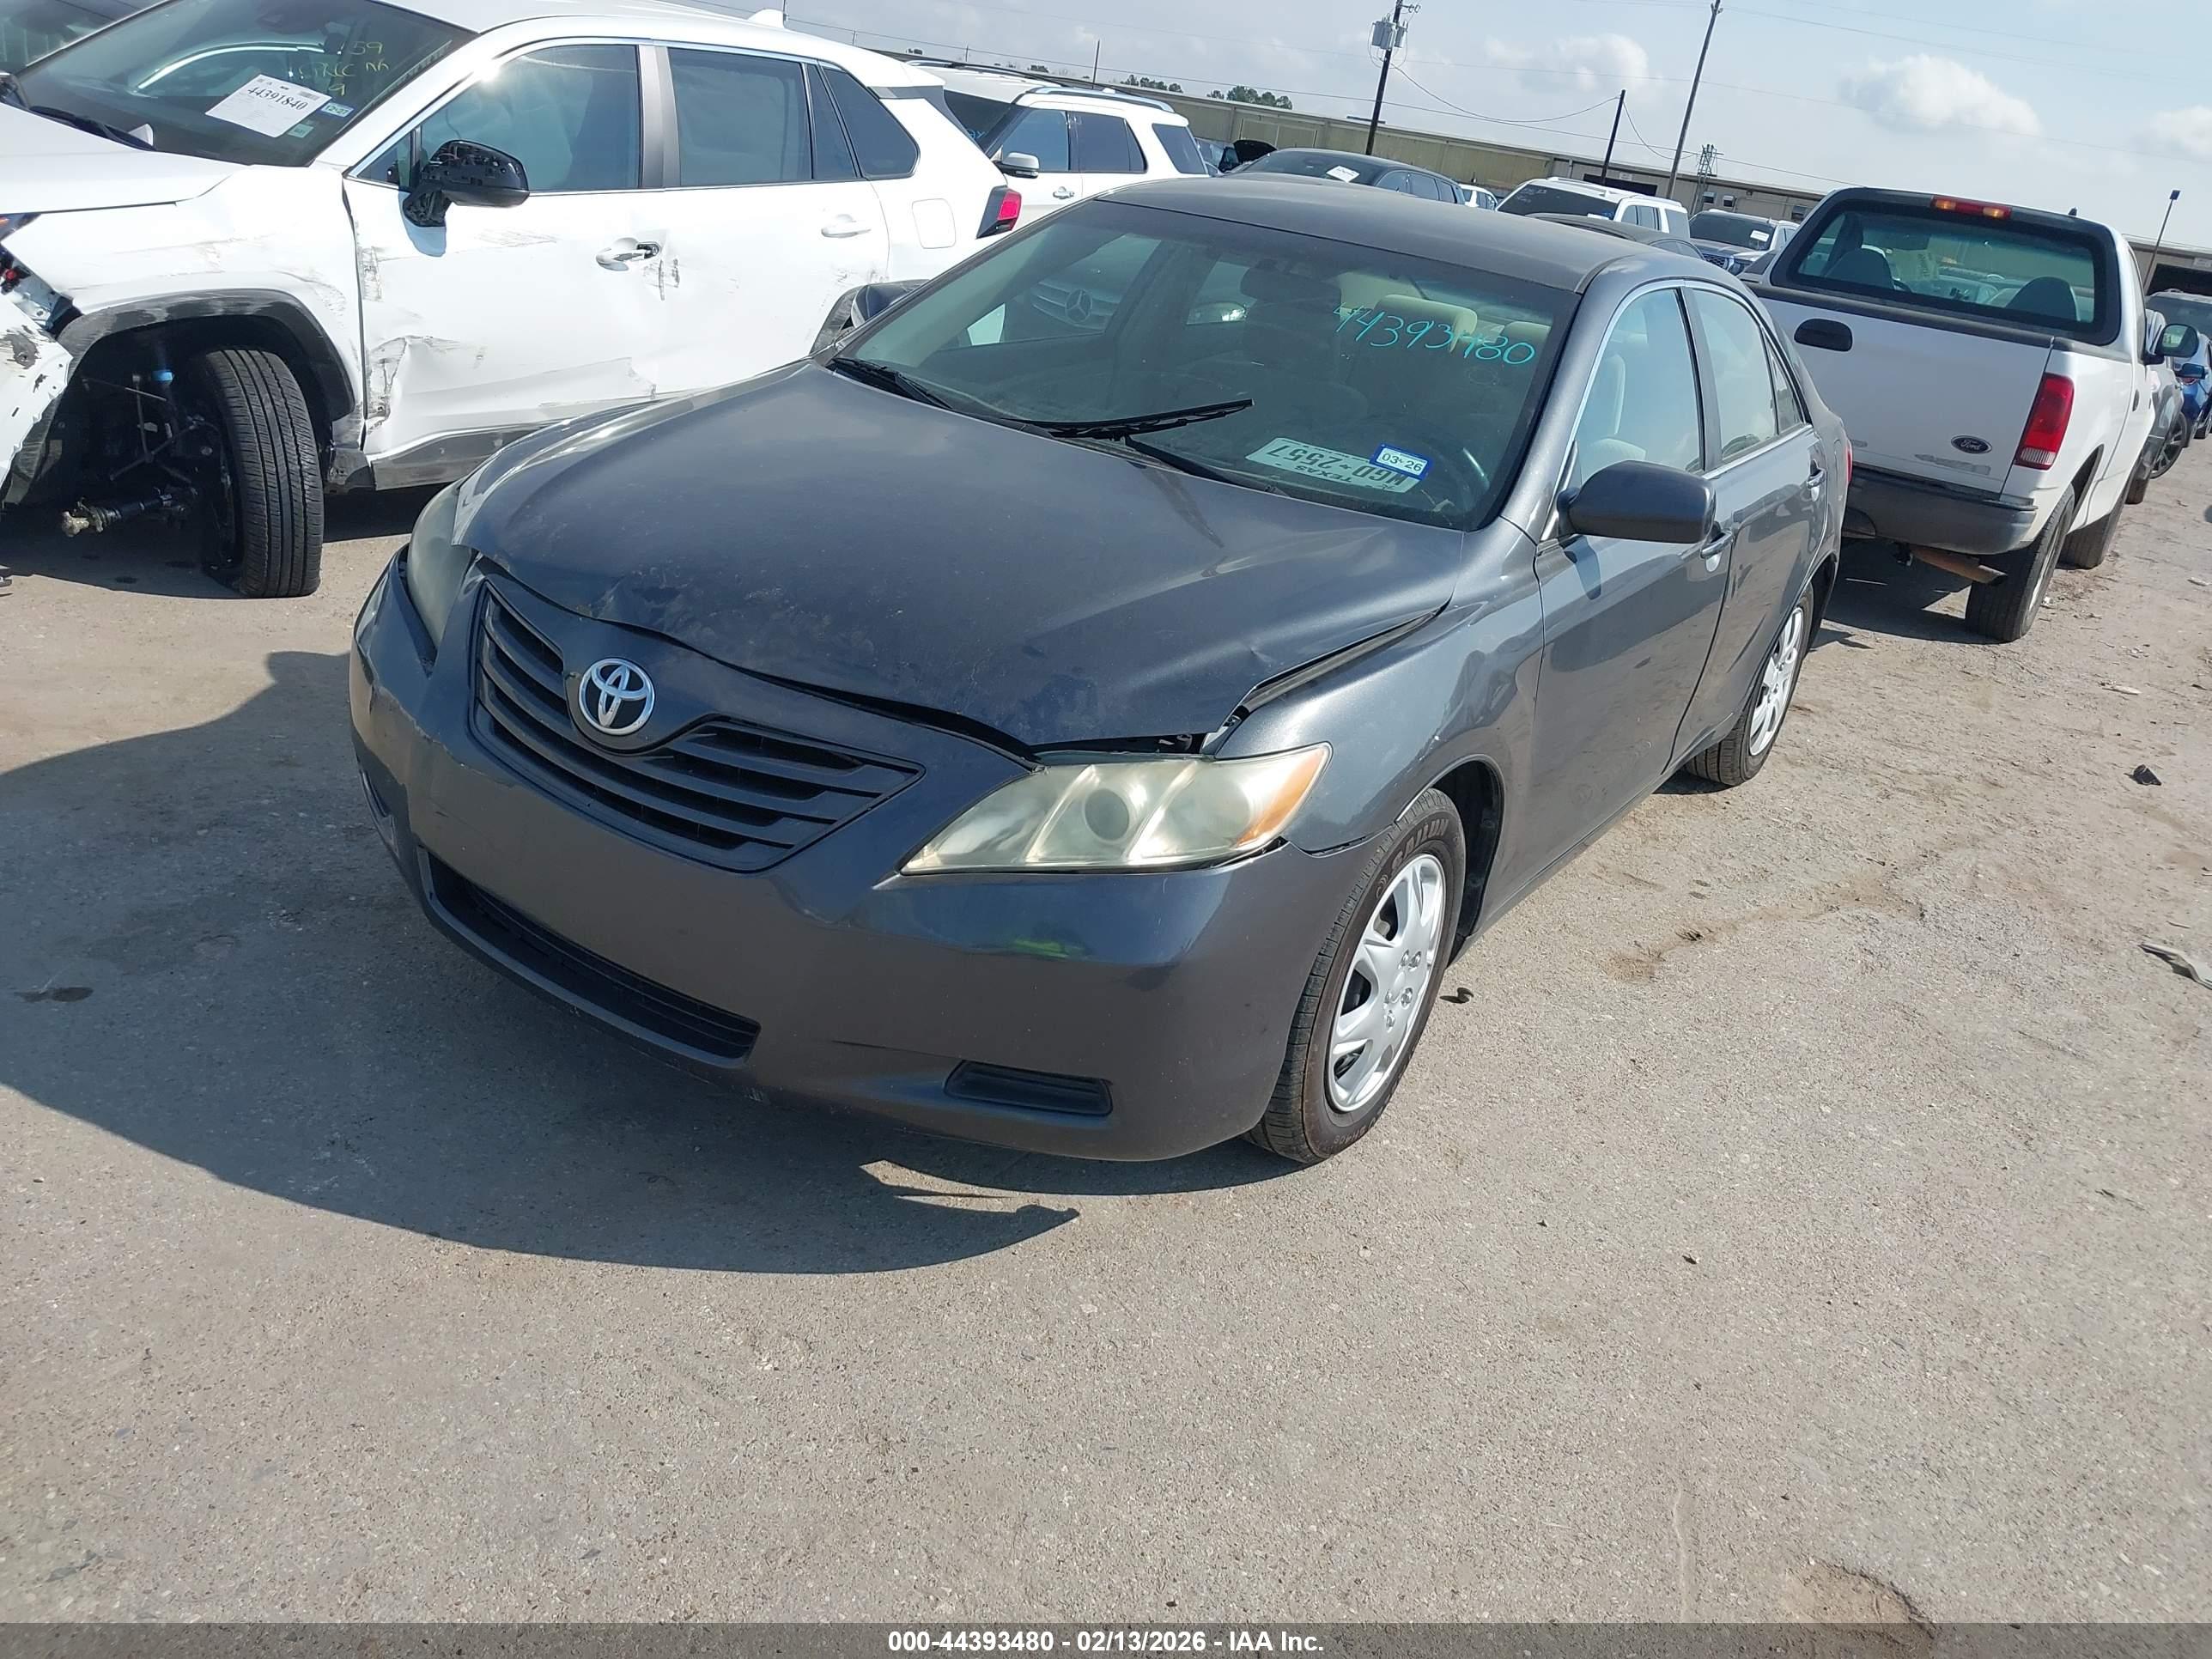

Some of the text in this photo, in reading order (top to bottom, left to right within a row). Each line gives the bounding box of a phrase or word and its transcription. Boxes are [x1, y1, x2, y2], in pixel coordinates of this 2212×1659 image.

[247, 86, 309, 111] 44391840
[1333, 301, 1535, 364] 44393480
[1294, 465, 1352, 483] TEXAS
